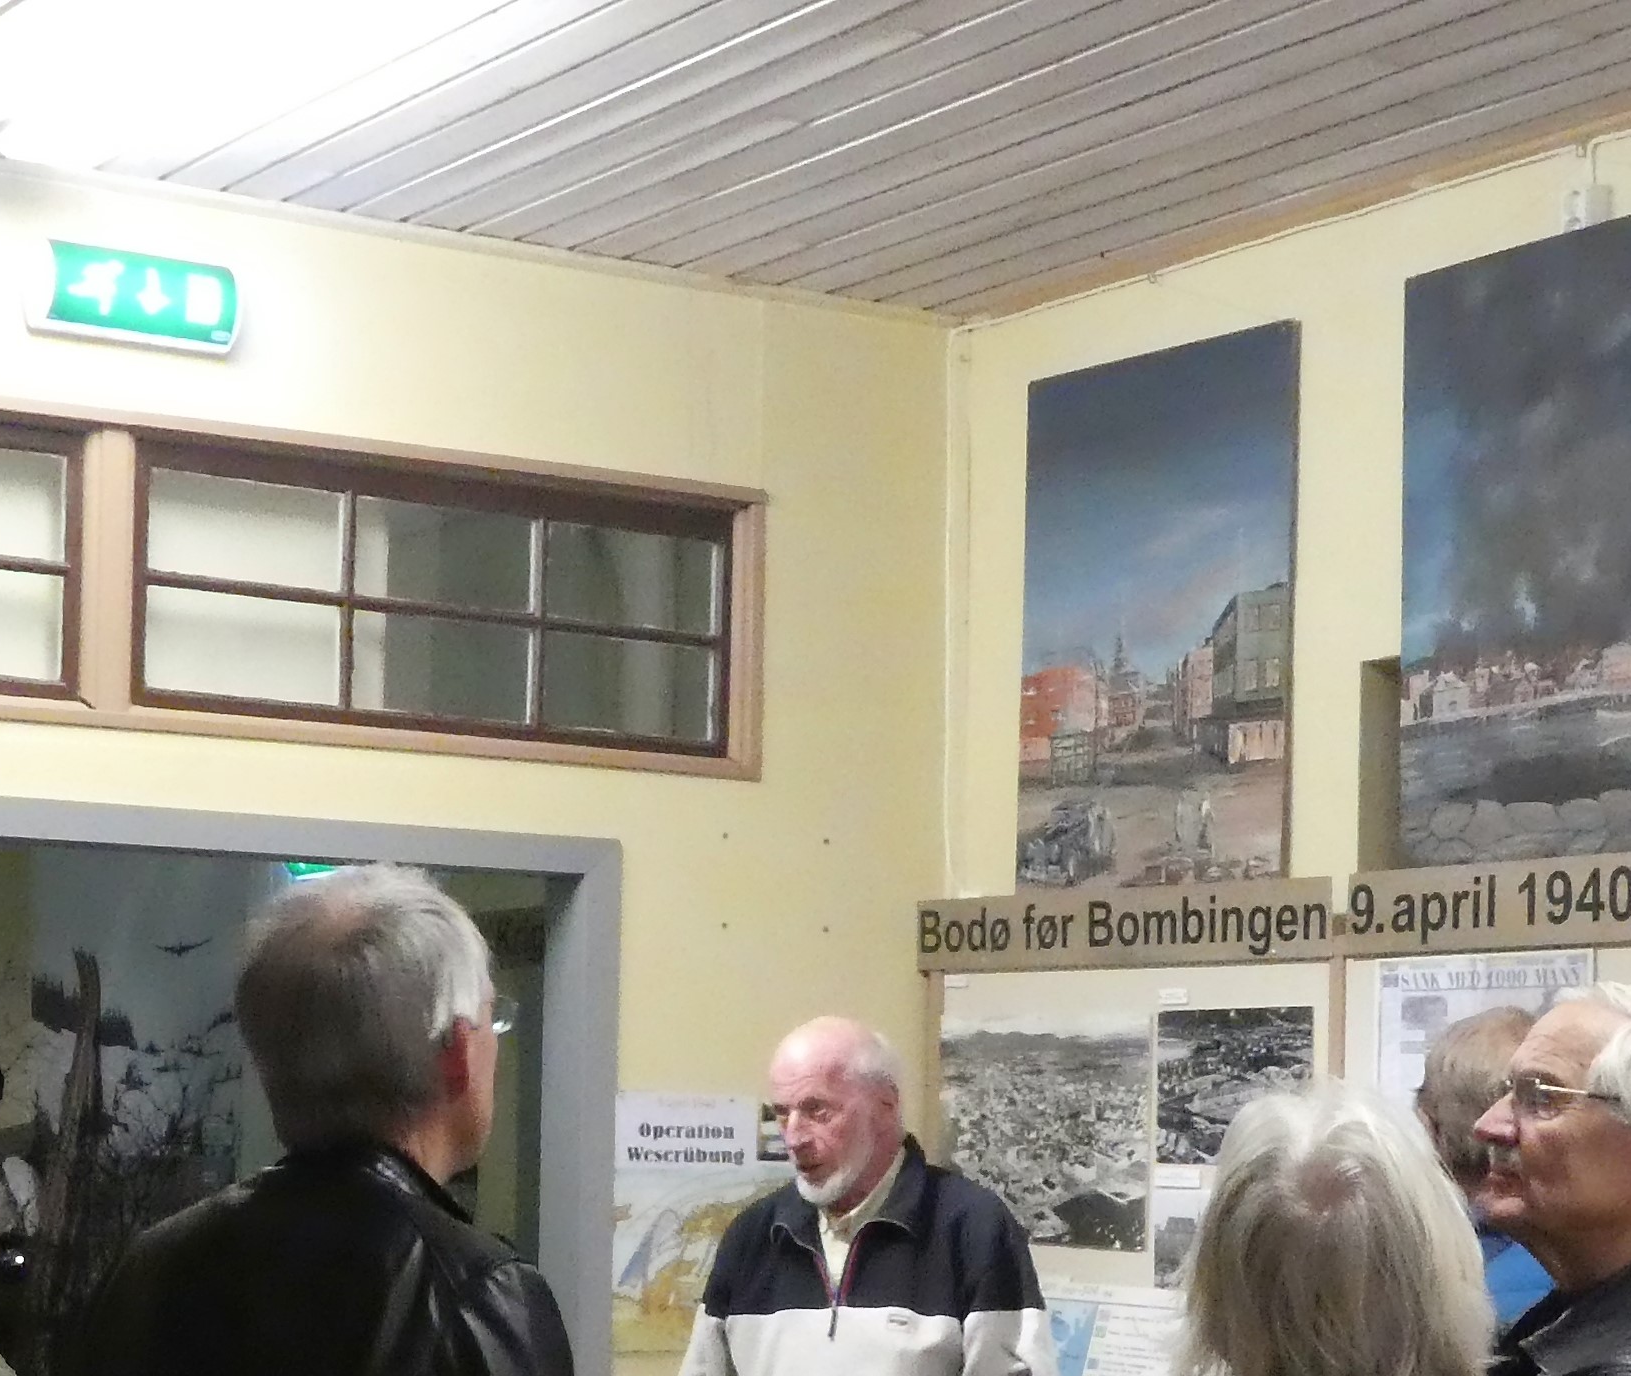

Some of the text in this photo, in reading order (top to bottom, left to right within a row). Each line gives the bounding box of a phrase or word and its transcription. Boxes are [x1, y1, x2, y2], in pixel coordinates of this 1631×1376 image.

[920, 895, 1328, 956] Bodø før Bombingen
[1350, 873, 1497, 945] 9.april
[638, 1122, 735, 1140] Operation
[627, 1146, 745, 1165] Weserübung
